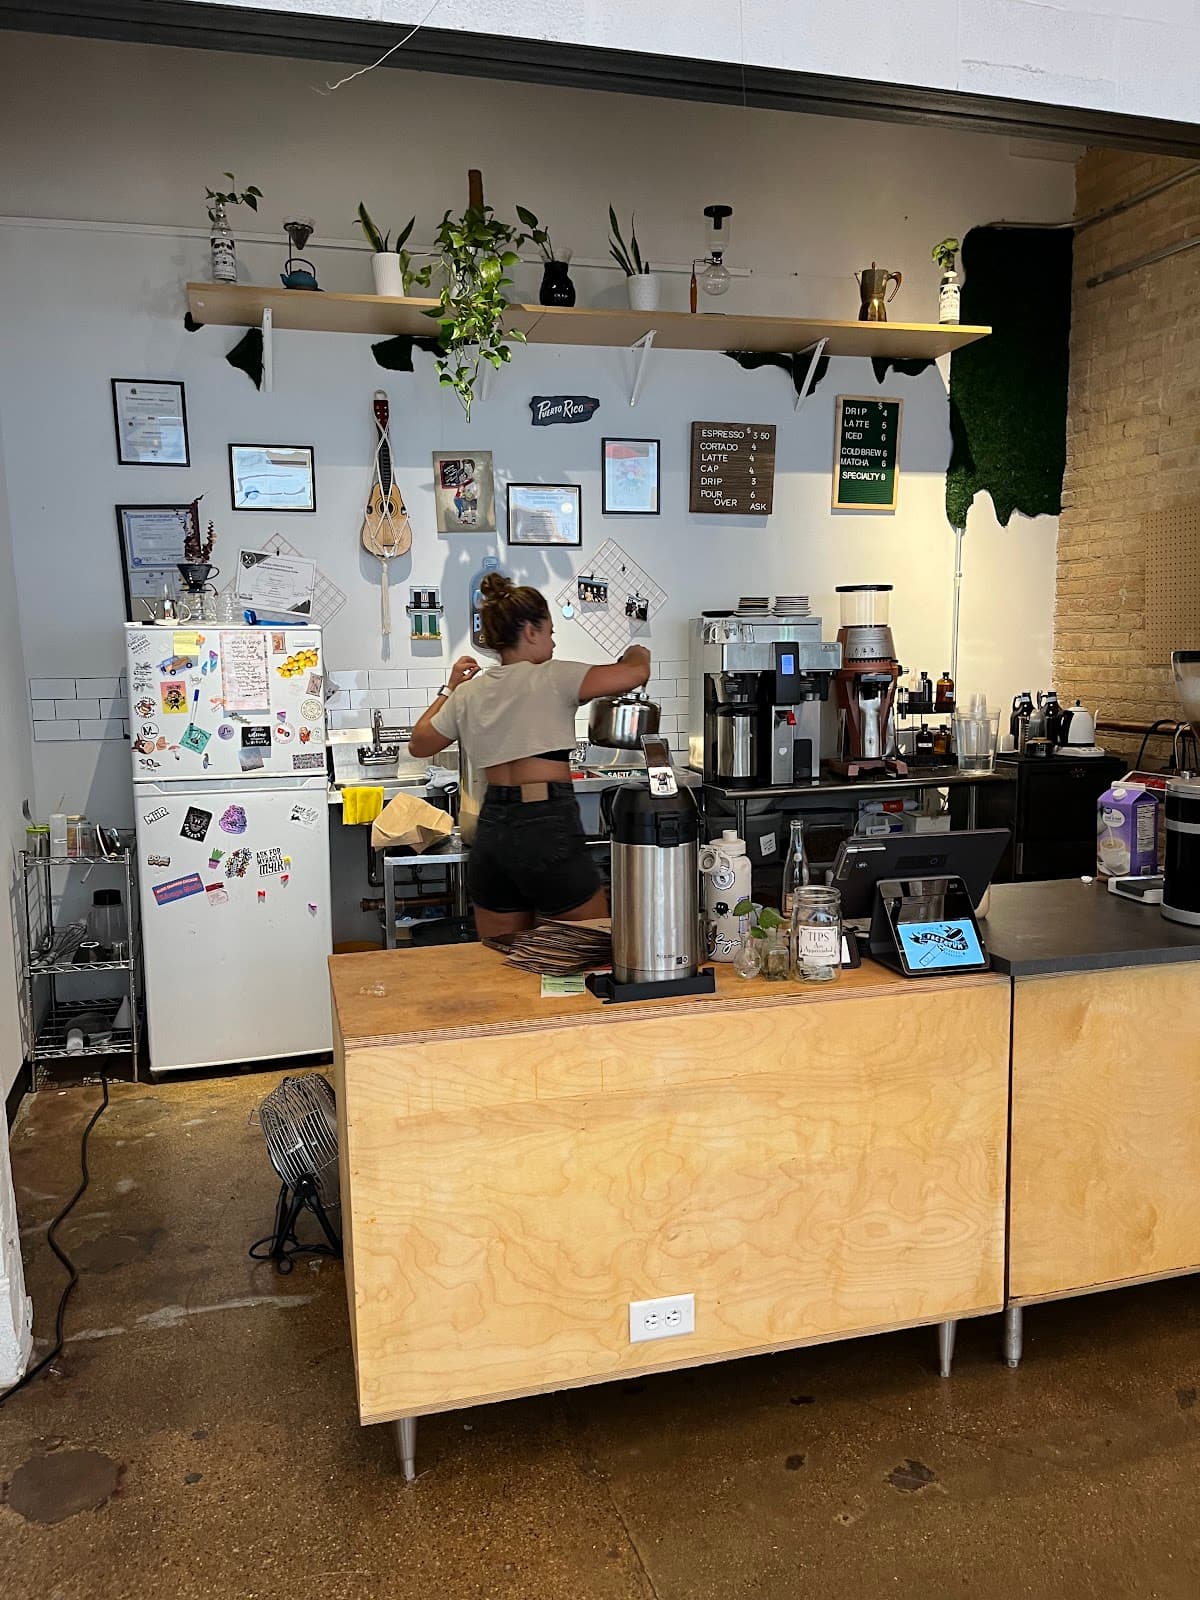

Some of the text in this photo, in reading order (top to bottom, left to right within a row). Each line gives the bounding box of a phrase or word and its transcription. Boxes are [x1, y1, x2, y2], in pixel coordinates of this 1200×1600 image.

[845, 407, 867, 415] DRIP
[883, 409, 888, 417] 4
[843, 419, 887, 430] LATTE 5
[701, 429, 745, 439] ESPRESSO
[845, 431, 887, 442] ICED 6
[700, 442, 757, 452] CORTADO 4
[701, 453, 755, 462] LATTE 4
[882, 450, 888, 458] 6
[840, 458, 887, 468] MATCHA 6
[700, 465, 755, 475] CAP 4
[841, 471, 886, 481] SPECIALTY 8
[701, 477, 757, 486] DRIP 3
[700, 489, 756, 499] POUR 6
[713, 498, 767, 511] OVER ASK
[269, 847, 281, 857] FOR
[808, 931, 830, 941] TIPS
